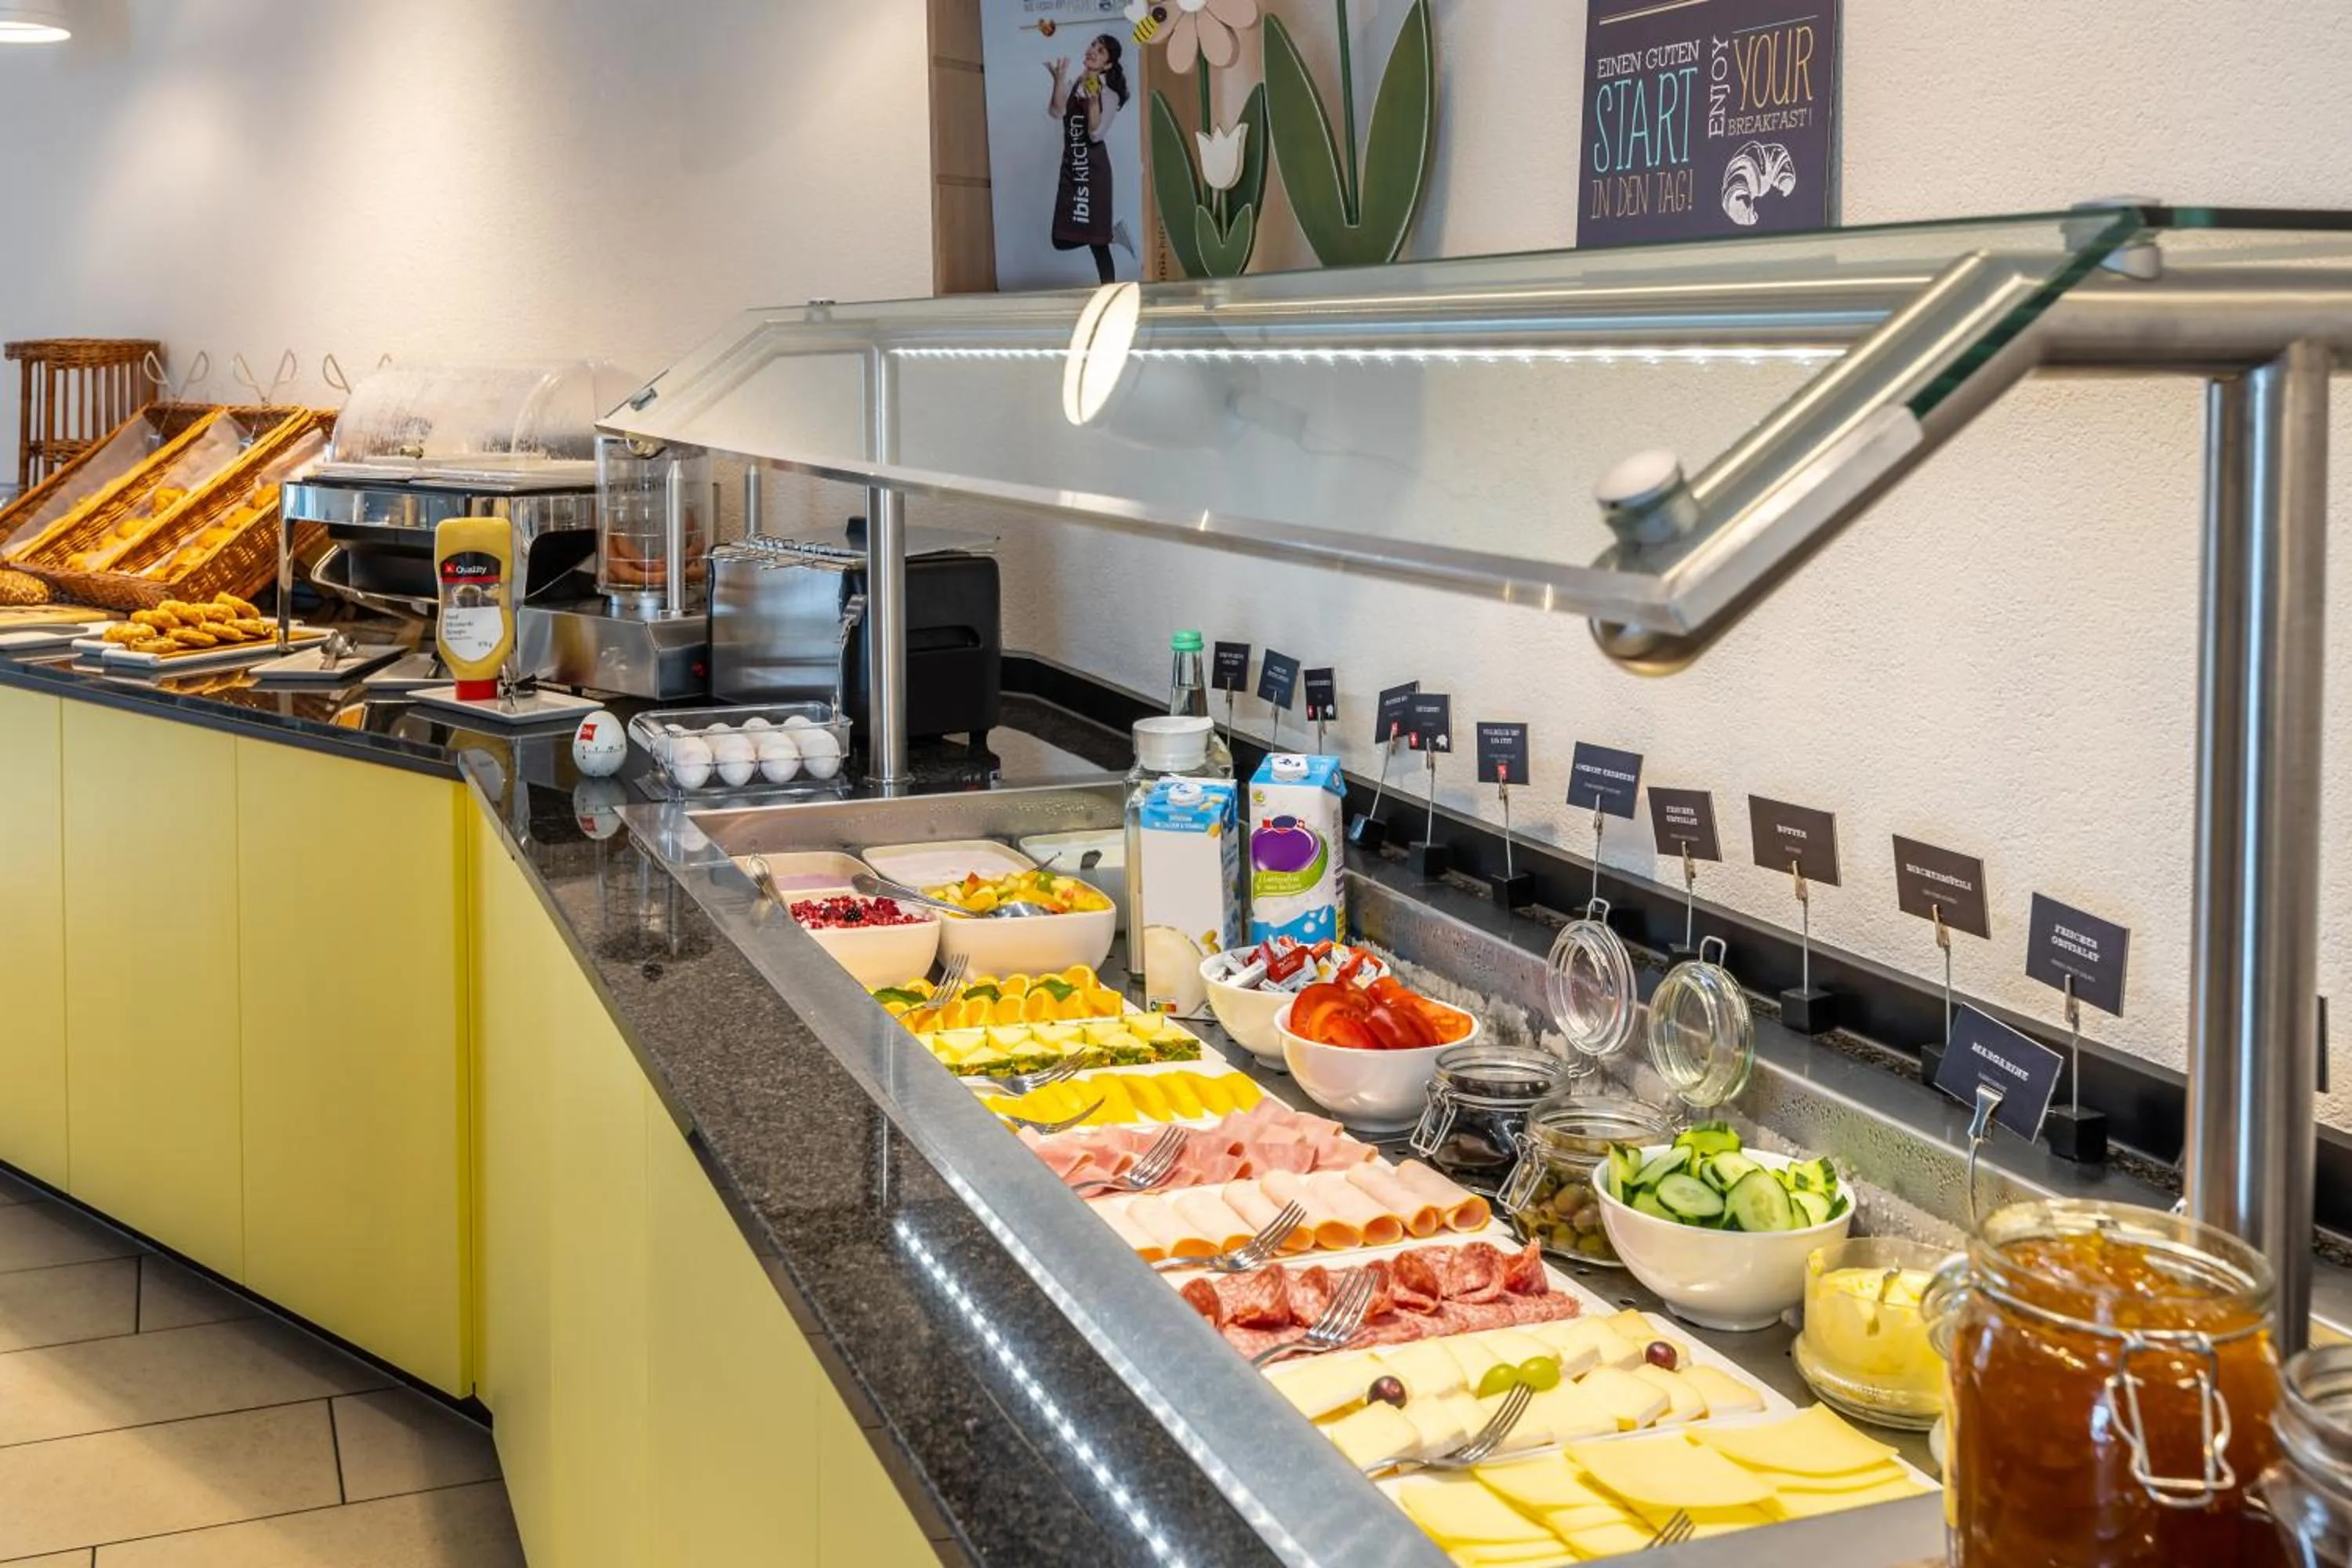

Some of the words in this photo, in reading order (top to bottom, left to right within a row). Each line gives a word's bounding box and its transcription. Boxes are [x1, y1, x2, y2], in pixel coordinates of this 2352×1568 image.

[1597, 49, 1641, 79] EINEN
[1646, 39, 1700, 68] GUTEN
[1733, 26, 1813, 111] YOUR
[1708, 34, 1731, 138] ENJOY
[1594, 67, 1697, 172] START
[1727, 107, 1812, 136] BREAKFAST!
[1070, 115, 1089, 183] kitchen
[1073, 186, 1089, 224] ibis
[1591, 179, 1610, 220] IN
[1616, 175, 1650, 217] DEN
[1657, 169, 1693, 214] TAG!
[456, 565, 486, 574] Quality
[1970, 1041, 2029, 1082] MARGARINE
